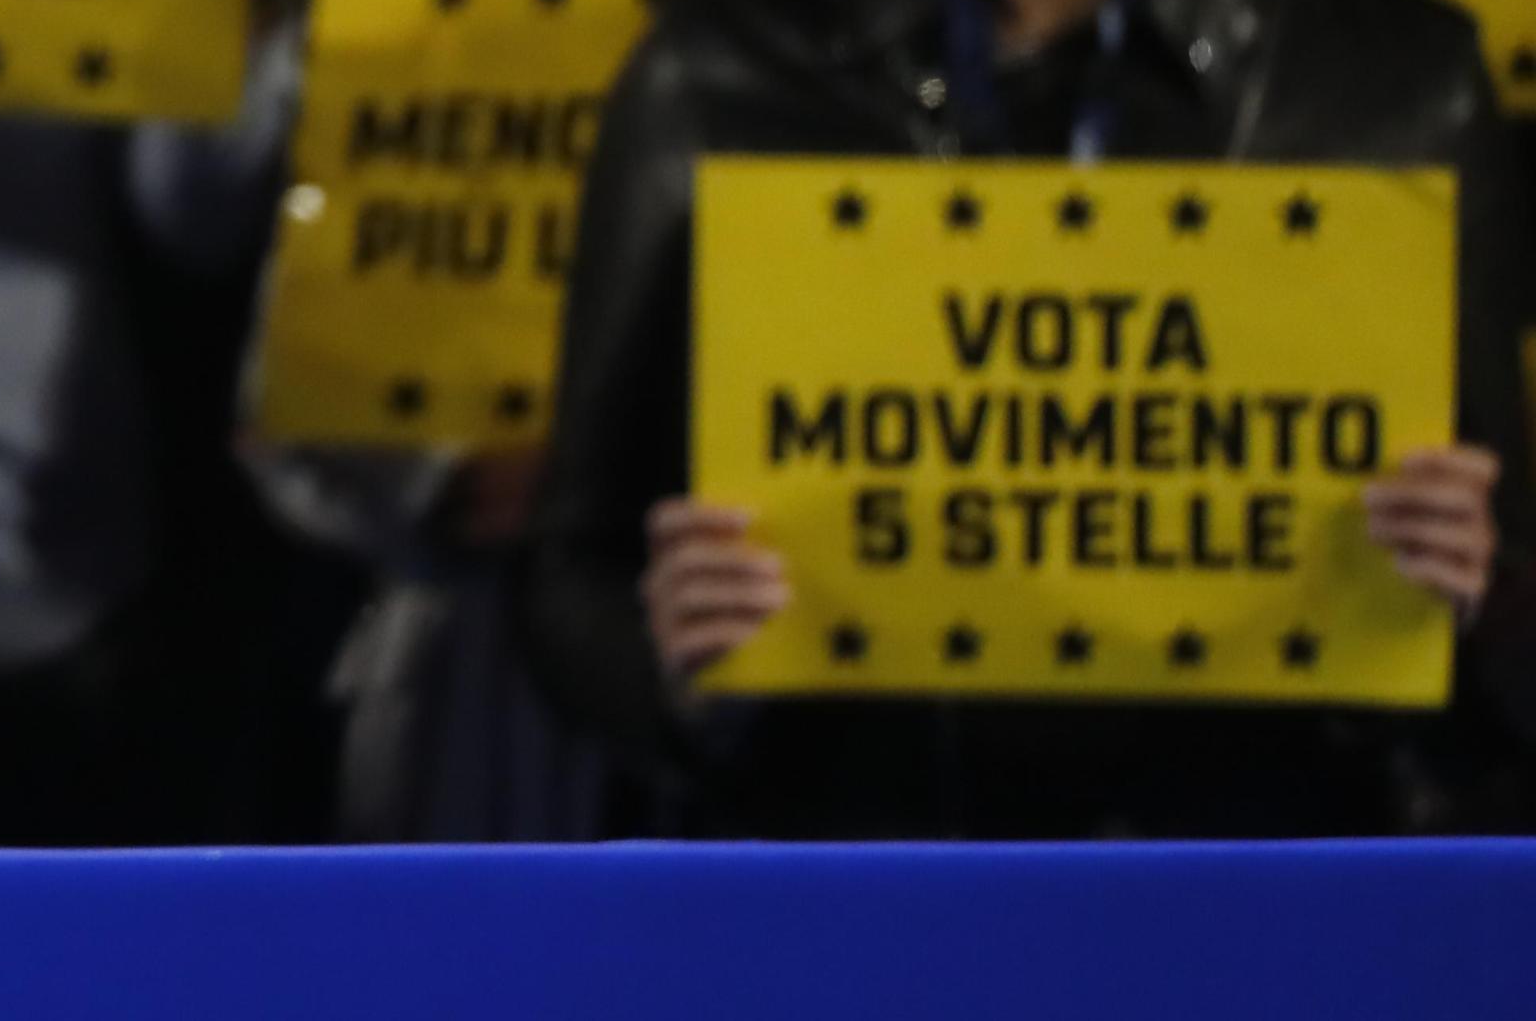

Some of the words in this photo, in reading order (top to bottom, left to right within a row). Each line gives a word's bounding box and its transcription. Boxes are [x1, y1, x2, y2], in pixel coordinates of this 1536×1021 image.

[940, 290, 1210, 374] VOTA
[764, 386, 1383, 476] MOVIMENTO
[851, 484, 913, 568] 5
[937, 486, 1298, 574] STELLE
